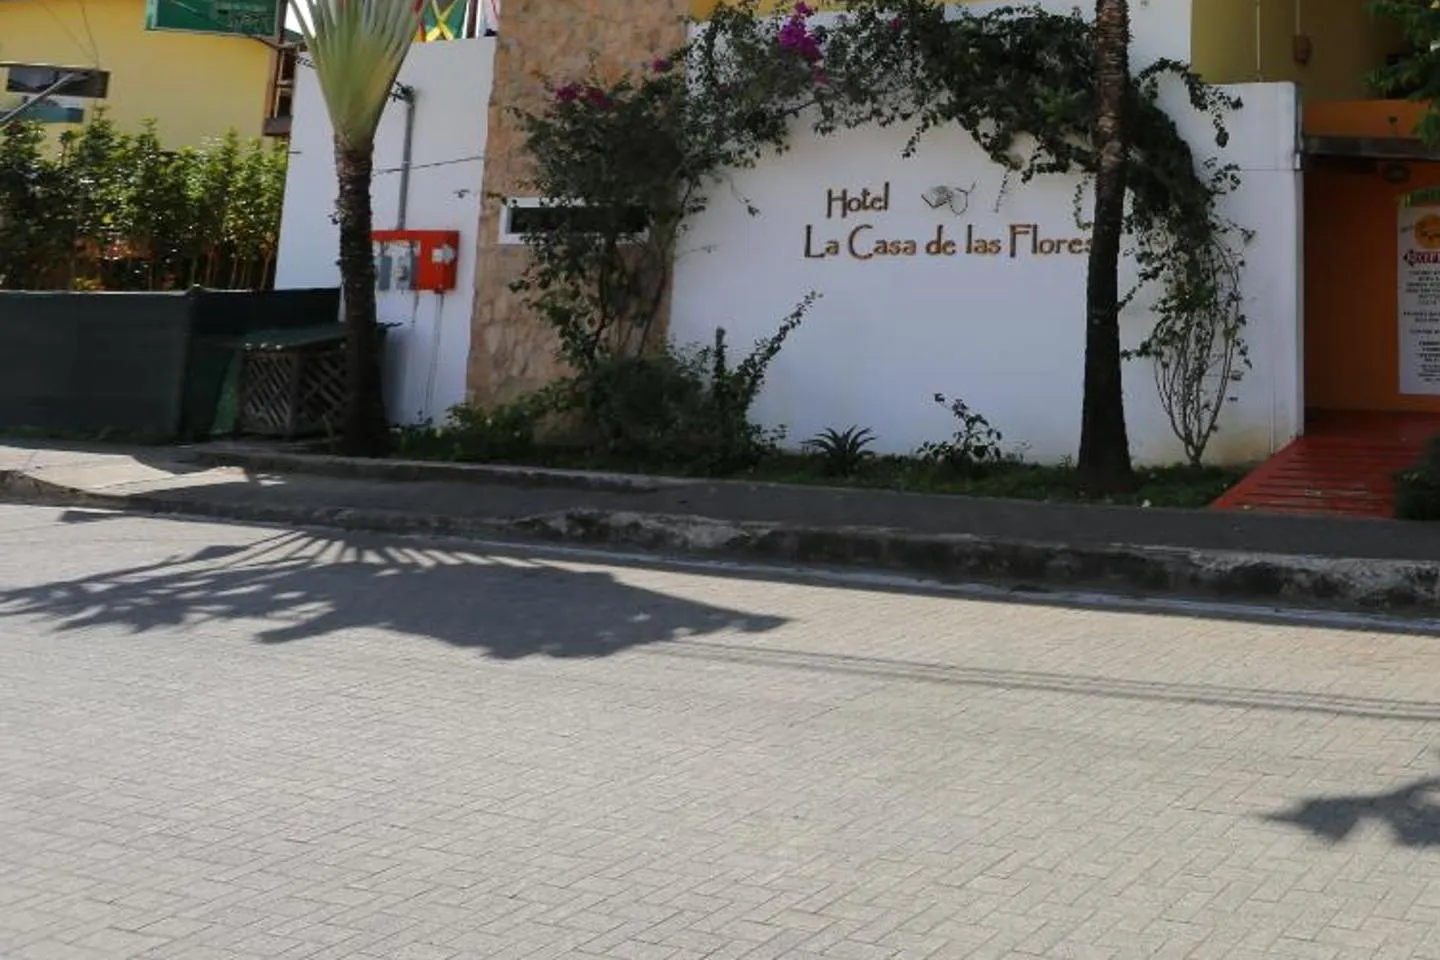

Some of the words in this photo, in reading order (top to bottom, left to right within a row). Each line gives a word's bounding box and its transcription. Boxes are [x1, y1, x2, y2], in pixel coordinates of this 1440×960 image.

[826, 182, 890, 218] Hotel
[803, 224, 840, 258] La
[848, 224, 917, 260] Casa
[925, 224, 956, 255] de
[966, 224, 1001, 254] las
